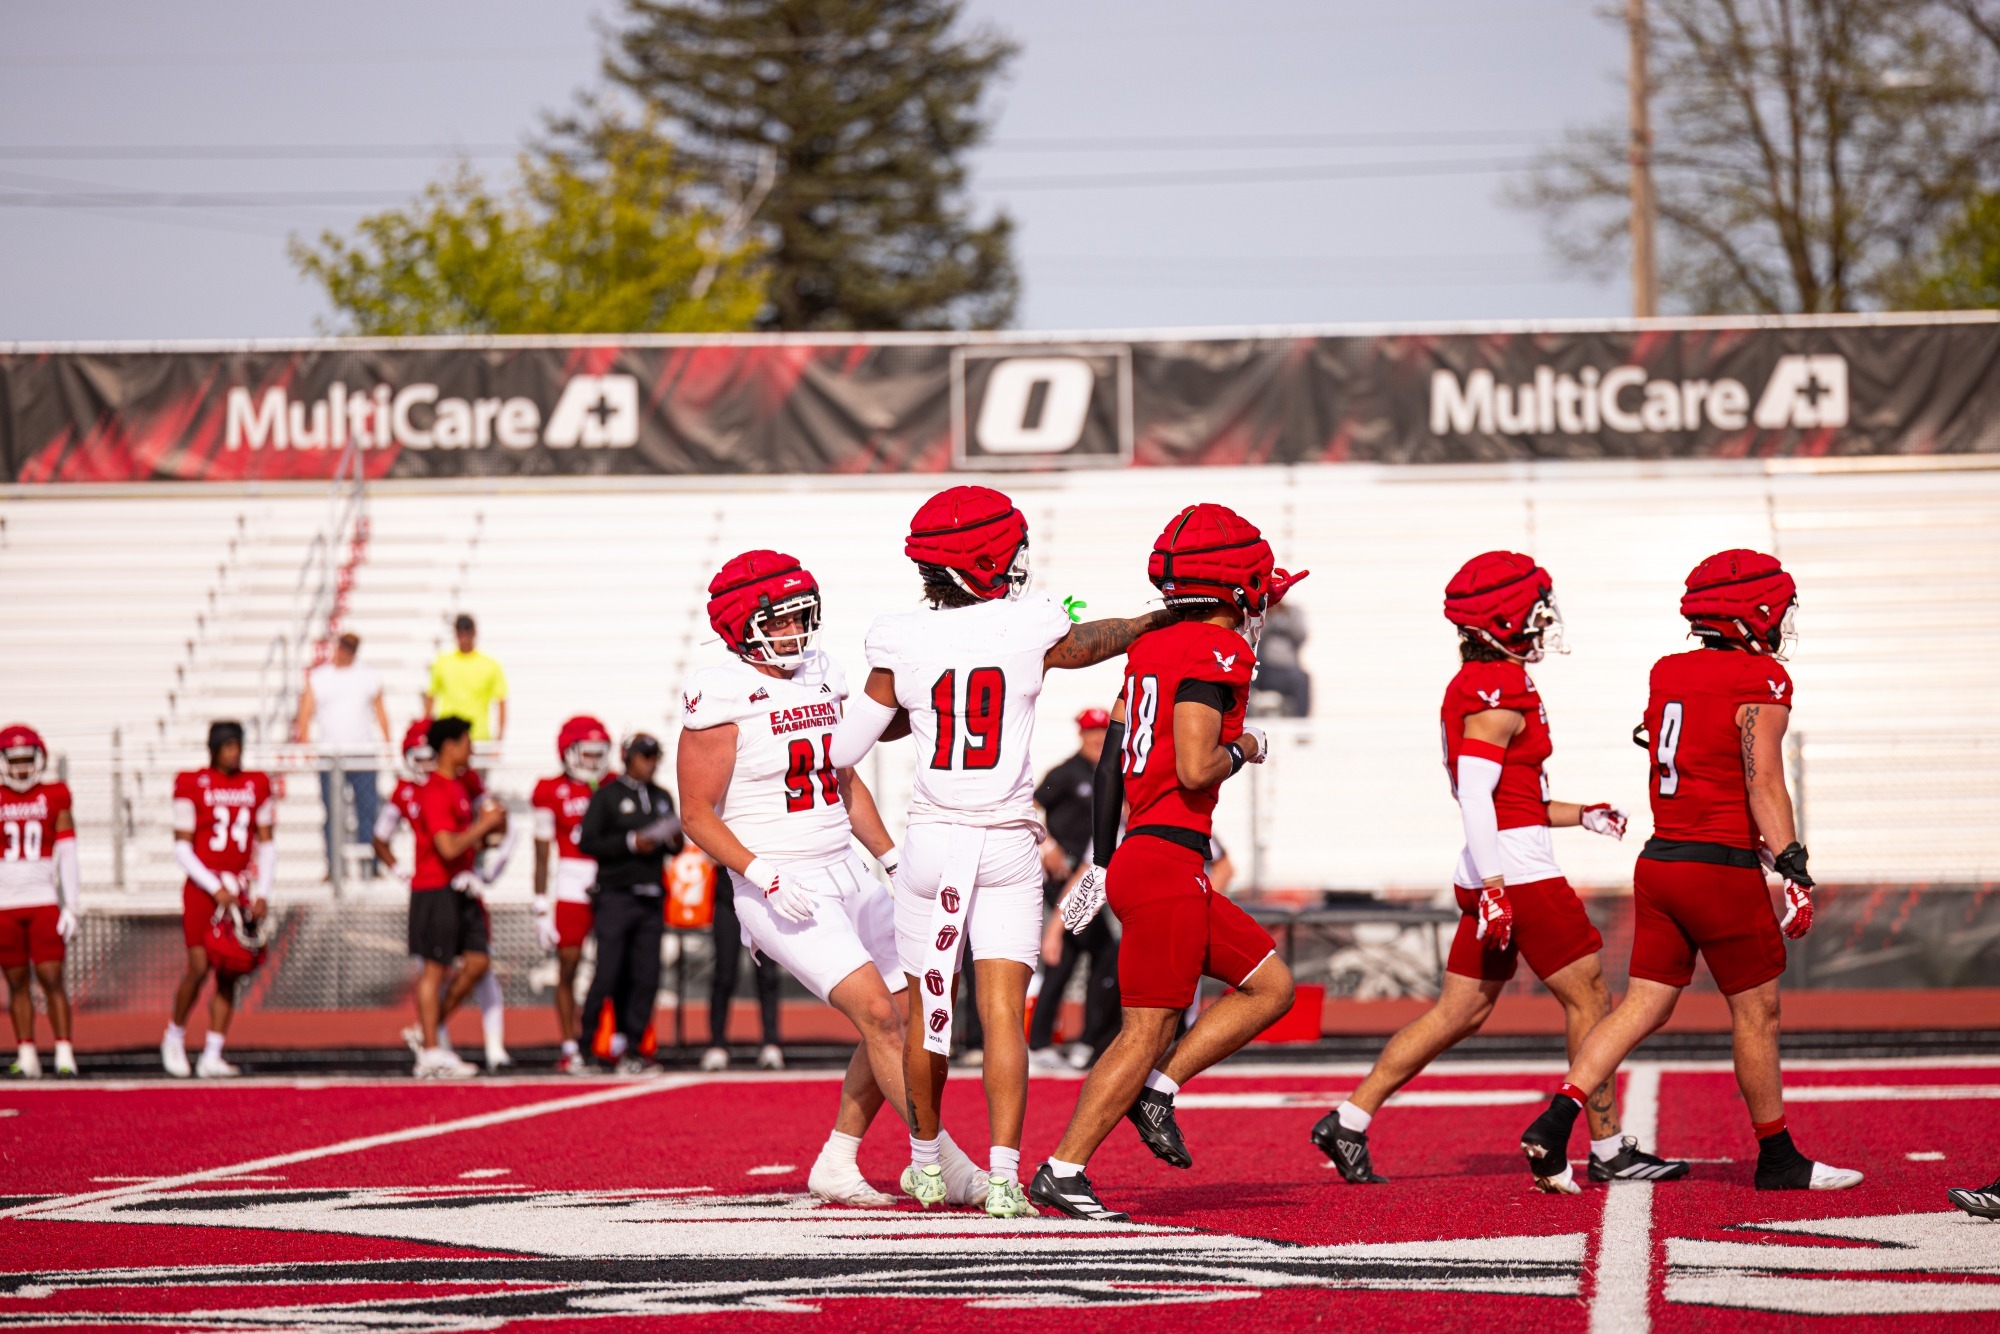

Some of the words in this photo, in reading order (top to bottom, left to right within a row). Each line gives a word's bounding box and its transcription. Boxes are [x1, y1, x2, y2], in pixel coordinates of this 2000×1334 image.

[226, 381, 541, 451] MultiCare
[1430, 365, 1749, 434] MultiCare
[1173, 597, 1219, 605] WASHINGTON
[769, 701, 836, 725] EASTERN
[771, 715, 838, 735] WASHINGTON
[929, 666, 1007, 771] 19
[1656, 701, 1684, 797] 9
[3, 820, 43, 861] 30
[208, 805, 251, 853] 34
